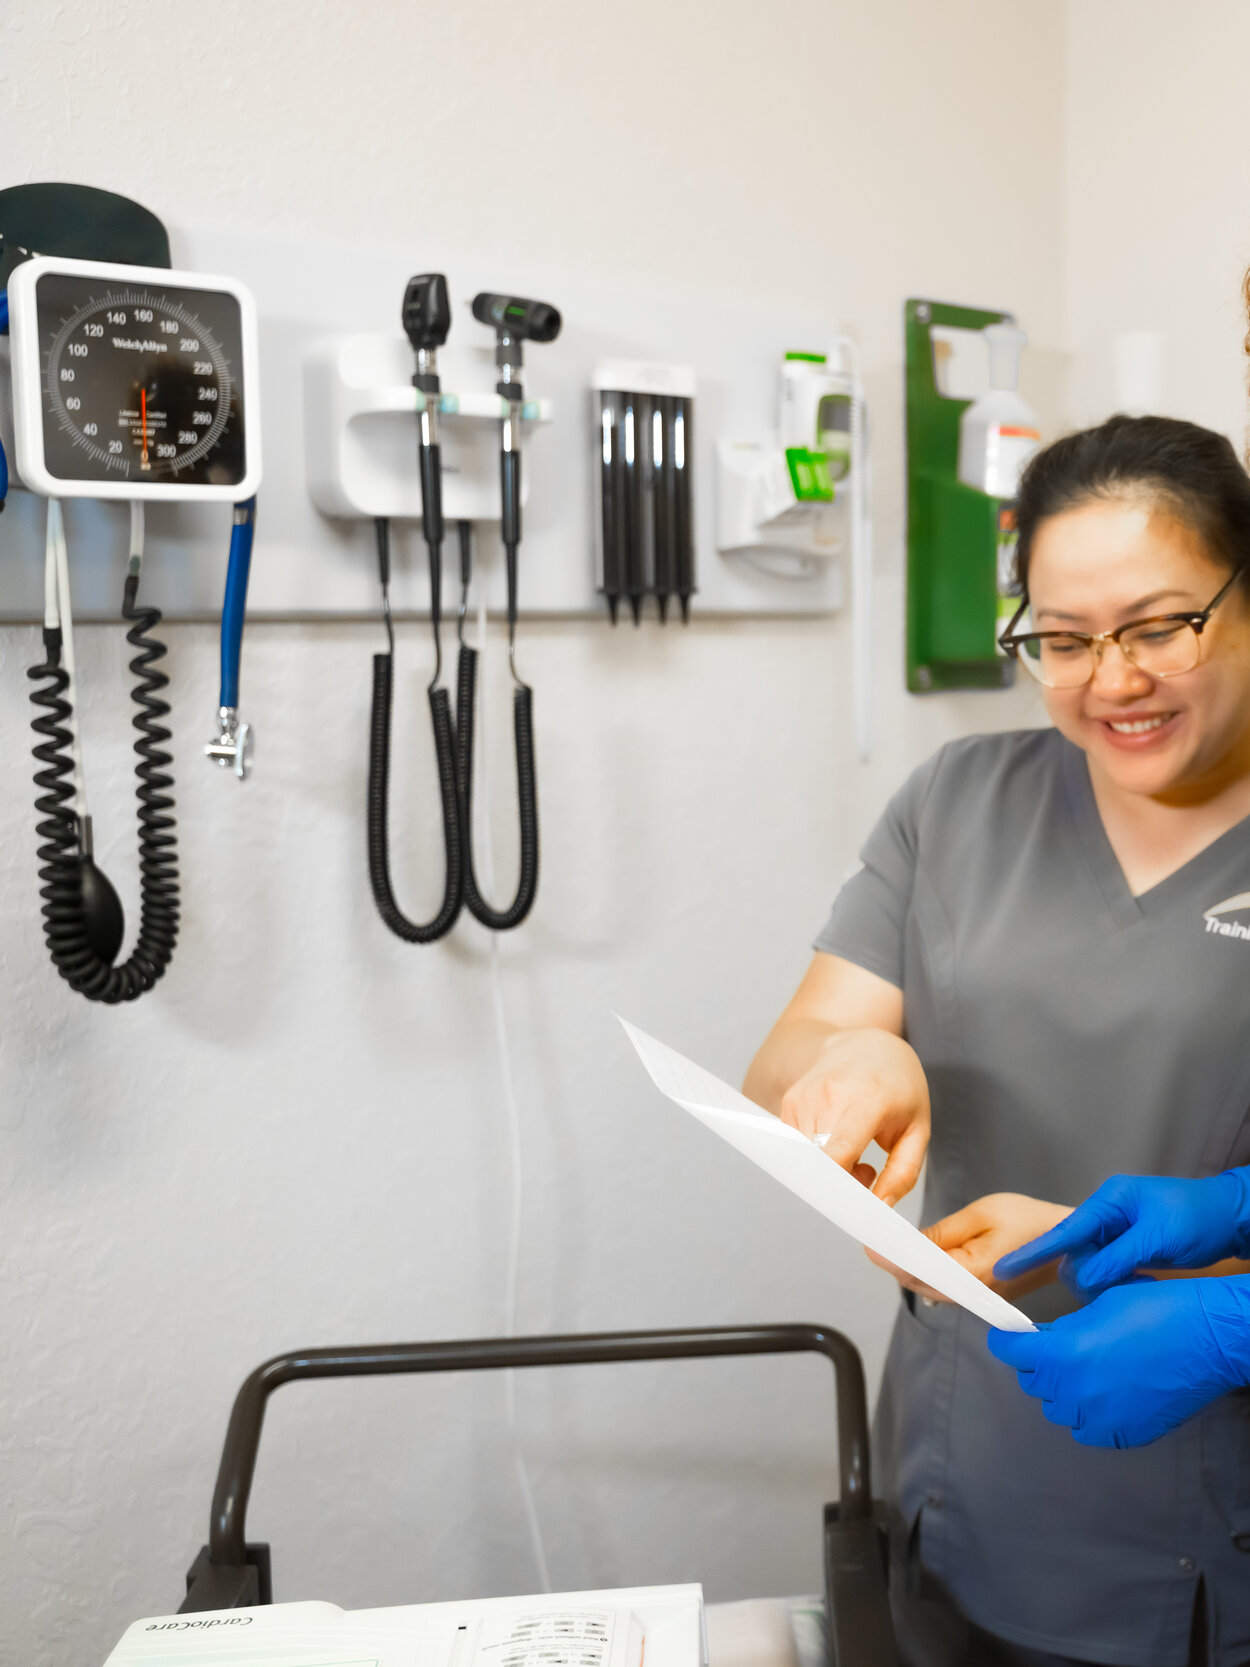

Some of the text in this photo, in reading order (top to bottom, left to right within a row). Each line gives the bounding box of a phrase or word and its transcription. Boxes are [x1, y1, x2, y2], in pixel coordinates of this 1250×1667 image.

[106, 311, 127, 325] 140
[134, 309, 154, 323] 160
[83, 323, 104, 337] 120
[159, 320, 179, 335] 180
[67, 343, 88, 357] 100
[179, 338, 200, 352] 200
[60, 368, 75, 382] 80
[193, 361, 213, 376] 220
[198, 387, 218, 401] 240
[66, 397, 81, 410] 60
[193, 411, 213, 425] 260
[83, 422, 98, 436] 40
[178, 431, 198, 445] 280
[108, 439, 123, 454] 20
[156, 444, 177, 458] 300
[145, 1616, 253, 1632] CardioCare
